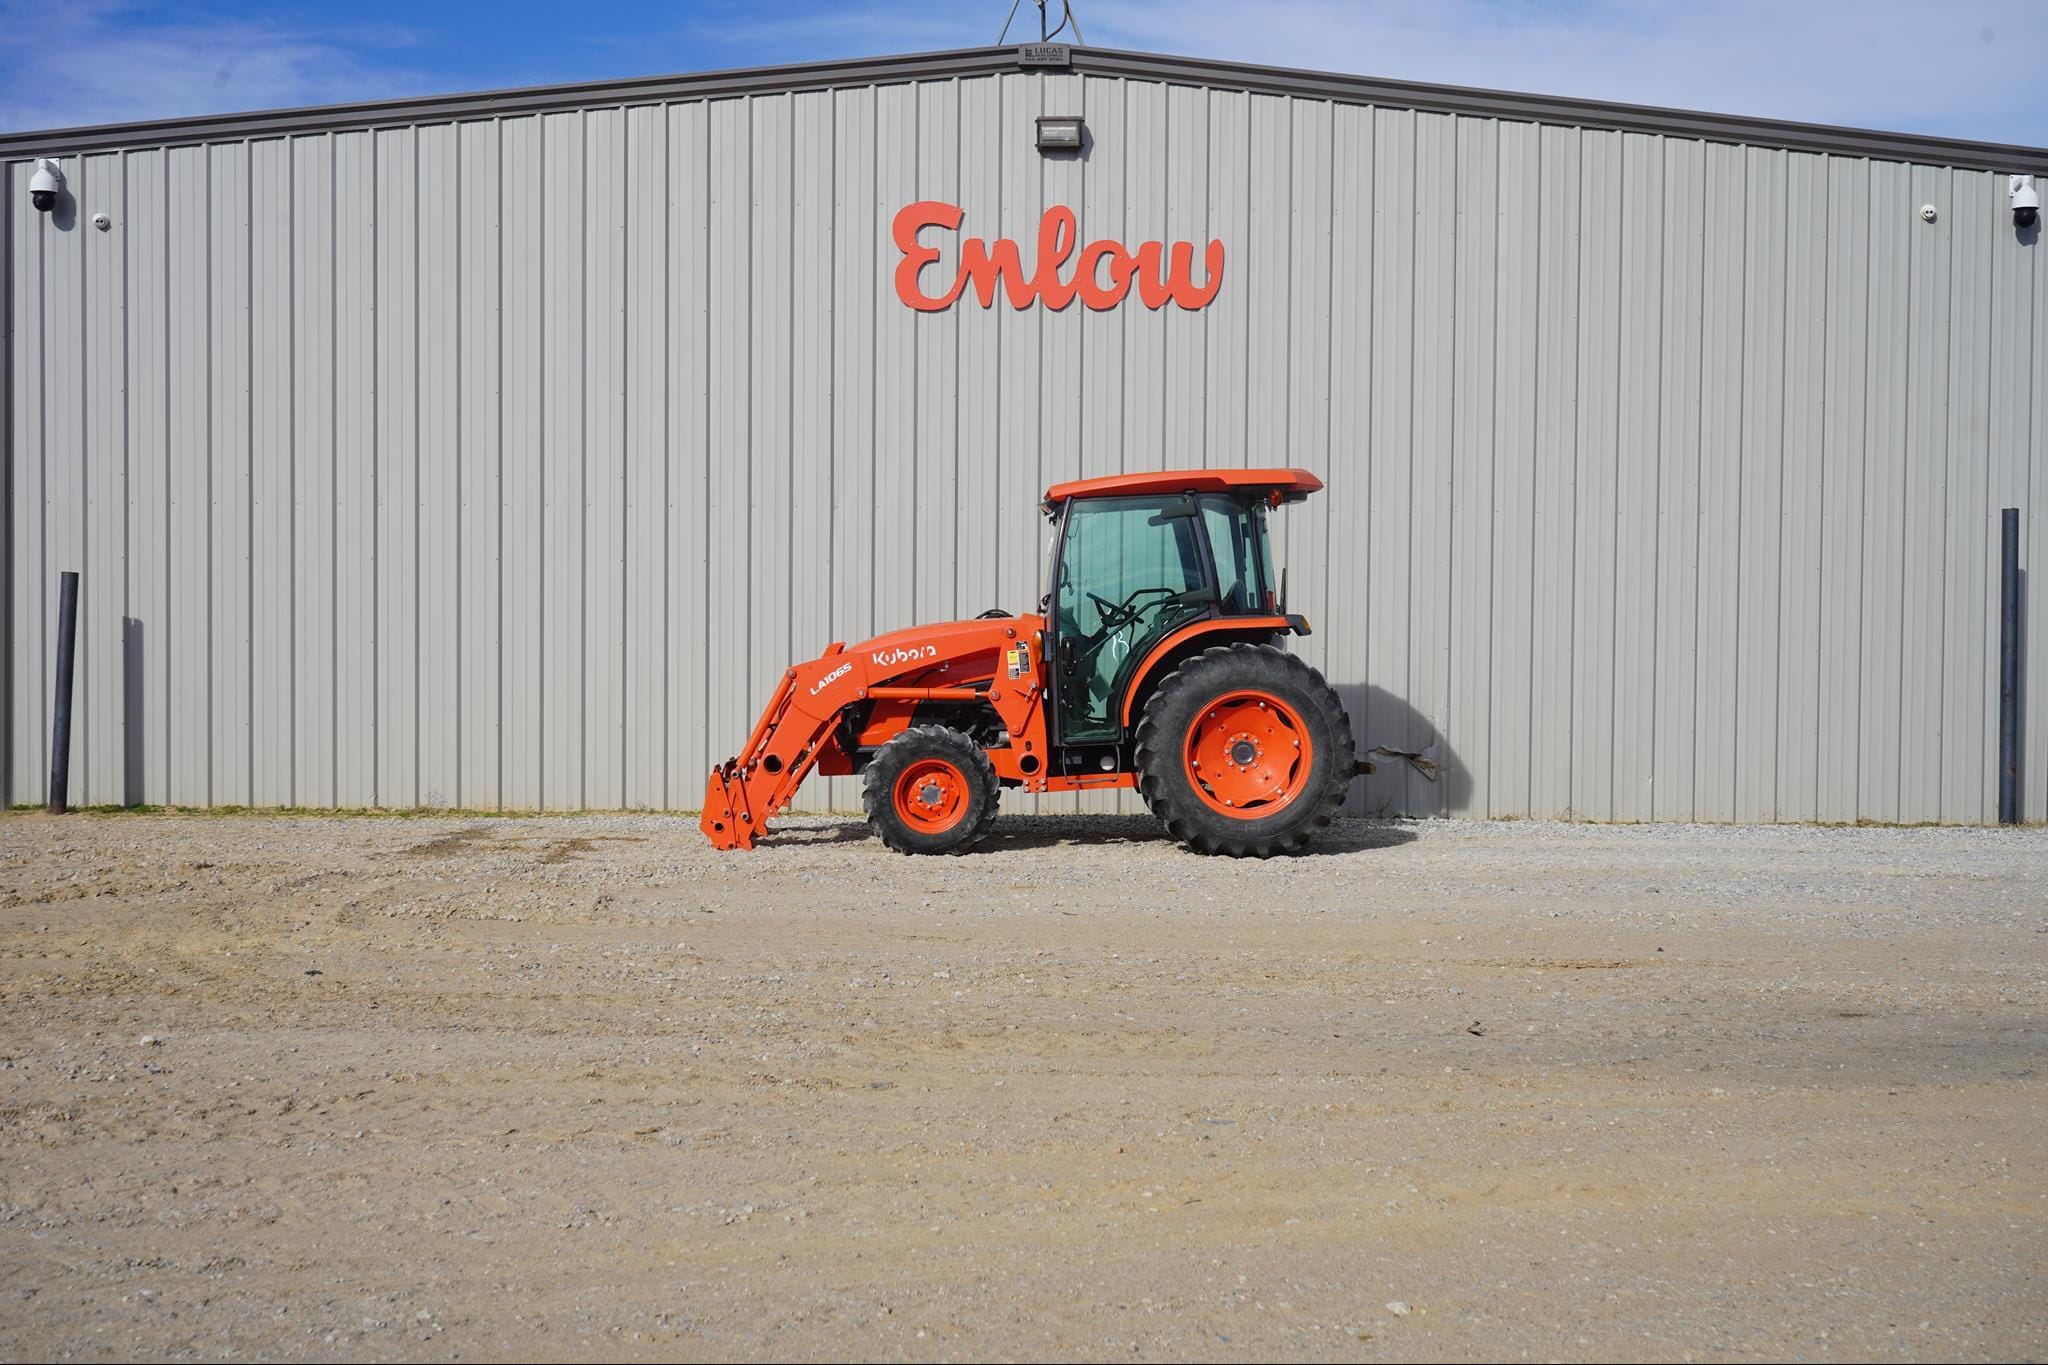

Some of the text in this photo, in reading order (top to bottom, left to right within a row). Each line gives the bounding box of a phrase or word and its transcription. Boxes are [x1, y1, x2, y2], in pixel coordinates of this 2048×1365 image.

[892, 201, 1225, 311] Enlow
[873, 645, 937, 666] Kubota
[810, 662, 852, 695] LA1065
